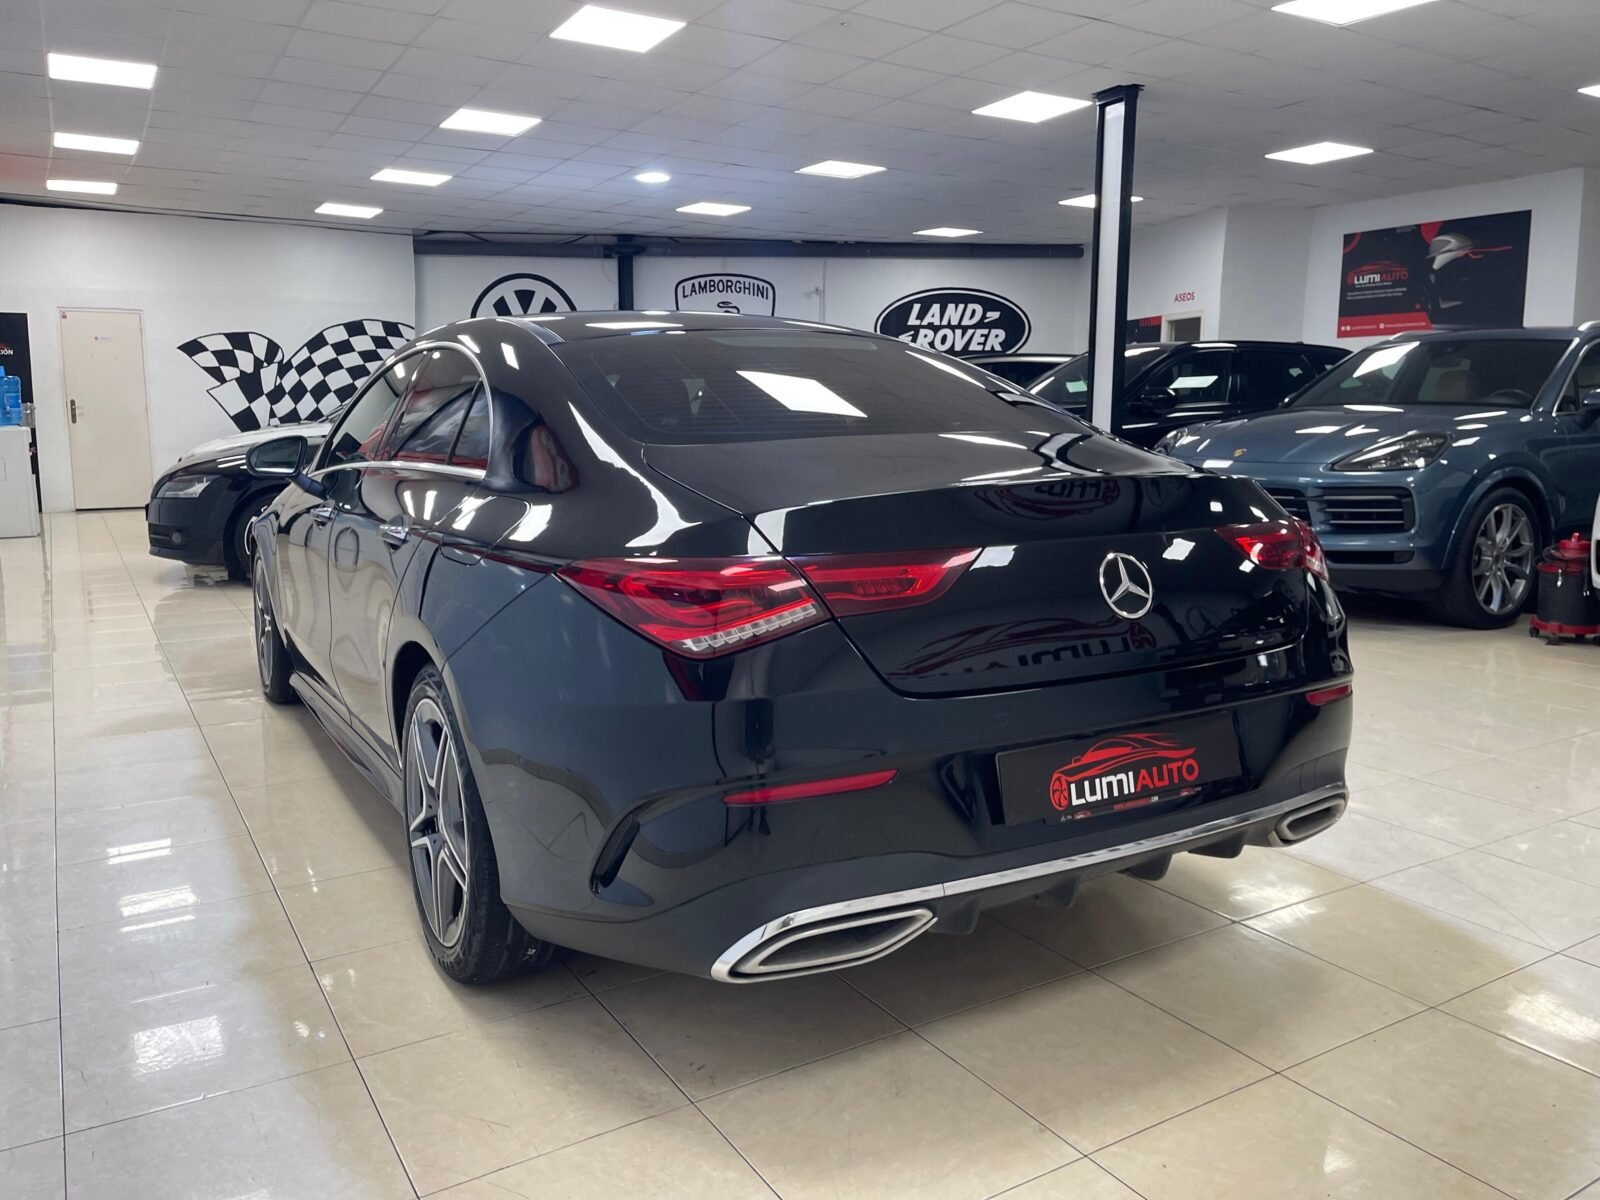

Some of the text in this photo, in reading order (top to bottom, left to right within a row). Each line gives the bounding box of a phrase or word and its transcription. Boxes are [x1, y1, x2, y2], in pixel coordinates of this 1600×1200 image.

[682, 279, 769, 300] LAMBORGHINI
[1174, 292, 1195, 303] ASEOS
[907, 303, 983, 326] LAND
[916, 328, 1006, 352] ROVER
[0, 348, 14, 356] IÓN
